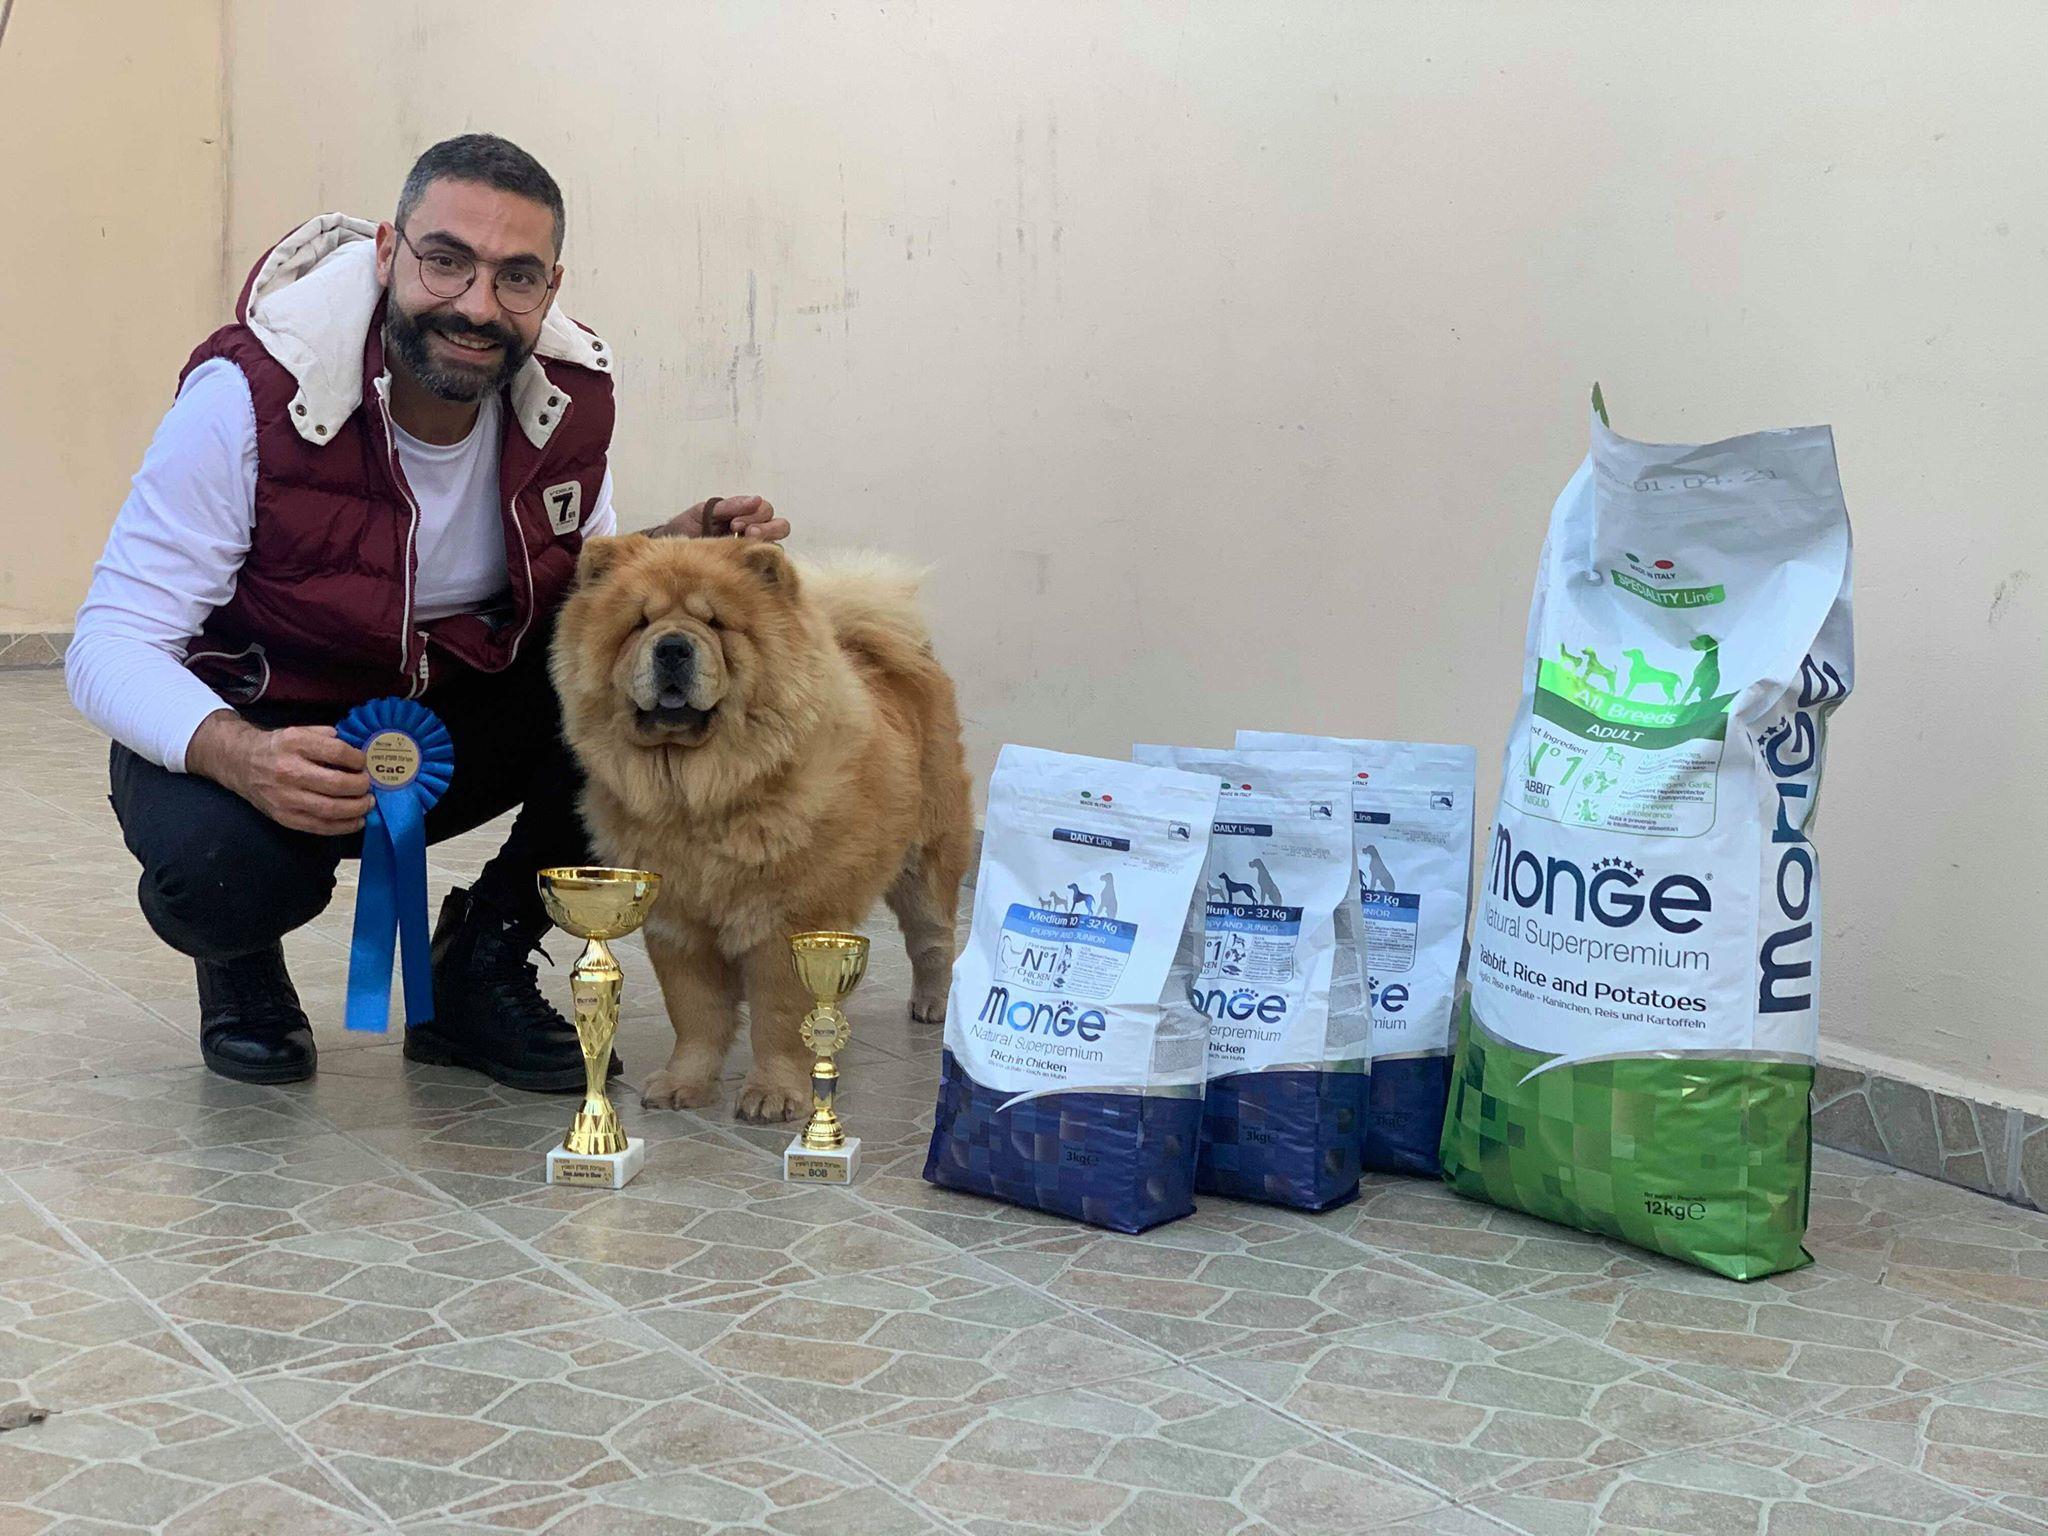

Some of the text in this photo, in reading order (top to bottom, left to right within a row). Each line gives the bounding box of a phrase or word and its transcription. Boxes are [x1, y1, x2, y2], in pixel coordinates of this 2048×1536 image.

[552, 491, 574, 523] 7
[1653, 572, 1676, 580] ITALY
[1617, 574, 1715, 605] SPECIALITY Line
[1572, 689, 1678, 726] All Breeds
[1585, 723, 1645, 743] ADULT
[1524, 779, 1555, 796] ABBIT
[1354, 813, 1372, 822] Line
[1213, 823, 1256, 834] DAILY Line
[1070, 832, 1113, 848] DAILY Line
[1364, 892, 1400, 907] 32 Kg
[1232, 907, 1245, 917] 10
[1255, 908, 1270, 919] 32
[1271, 909, 1287, 922] Kg
[1364, 908, 1391, 918] NIOR
[1028, 910, 1068, 926] Medium
[1069, 915, 1078, 926] 10
[1086, 918, 1101, 929] 32
[1102, 921, 1118, 935] Kg
[1031, 927, 1059, 939] PUPPY
[1074, 932, 1107, 945] JUNIOR
[1525, 919, 1710, 971] Superpremium
[1017, 967, 1051, 981] CHICKEN
[1513, 961, 1547, 988] Rice
[1551, 976, 1587, 998] and
[1595, 981, 1707, 1013] Potatoes
[1511, 984, 1535, 1001] Patate
[1542, 995, 1592, 1016] Kaninchen,
[1594, 1006, 1619, 1019] Reis
[1622, 1011, 1644, 1023] und
[1646, 1014, 1707, 1030] Kartoffeln
[1209, 1025, 1282, 1042] erpremium
[969, 1023, 1104, 1062] Natural Superpremium
[1208, 1041, 1246, 1054] hicken
[990, 1048, 1014, 1064] Rich
[1014, 1055, 1024, 1066] in
[1025, 1056, 1068, 1074] Chicken
[808, 1168, 828, 1178] BOB
